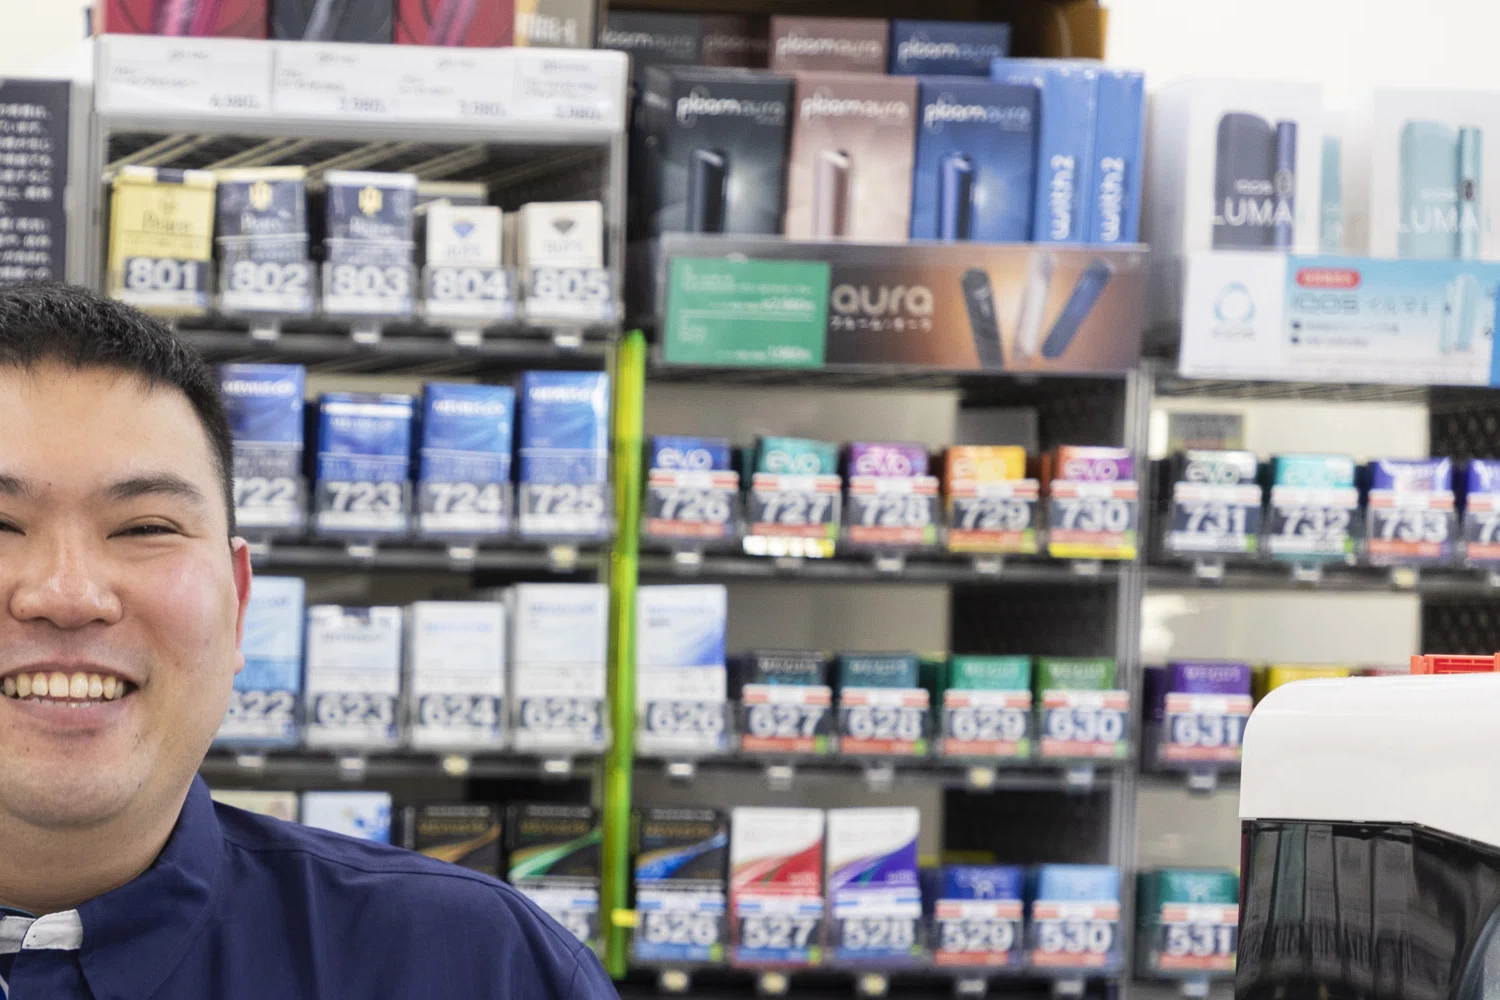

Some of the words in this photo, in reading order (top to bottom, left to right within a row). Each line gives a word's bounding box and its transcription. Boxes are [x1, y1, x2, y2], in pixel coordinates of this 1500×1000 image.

[126, 258, 199, 290] 801
[231, 261, 310, 294] 802
[332, 265, 411, 297] 803
[432, 267, 510, 300] 804
[533, 267, 611, 300] 805
[832, 285, 934, 316] aura
[329, 481, 401, 512] 723
[428, 482, 501, 513] 724
[532, 483, 605, 514] 725
[661, 491, 730, 522] 726
[759, 492, 832, 524] 727
[862, 494, 931, 526] 728
[961, 498, 1032, 530] 729
[1063, 498, 1130, 530] 730
[1186, 506, 1248, 533] 731
[1282, 508, 1351, 535] 732
[1382, 511, 1448, 541] 733
[314, 694, 393, 727] 623
[420, 696, 498, 728] 624
[521, 699, 600, 729] 625
[648, 700, 724, 732] 626
[749, 705, 826, 738] 627
[849, 707, 924, 739] 628
[953, 708, 1026, 741] 629
[1049, 708, 1124, 741] 630
[1173, 714, 1244, 746] 631
[647, 910, 720, 945] 526
[742, 914, 815, 949] 527
[844, 915, 915, 950] 528
[942, 919, 1015, 952] 529
[1039, 921, 1113, 954] 530
[1166, 924, 1234, 956] 531
